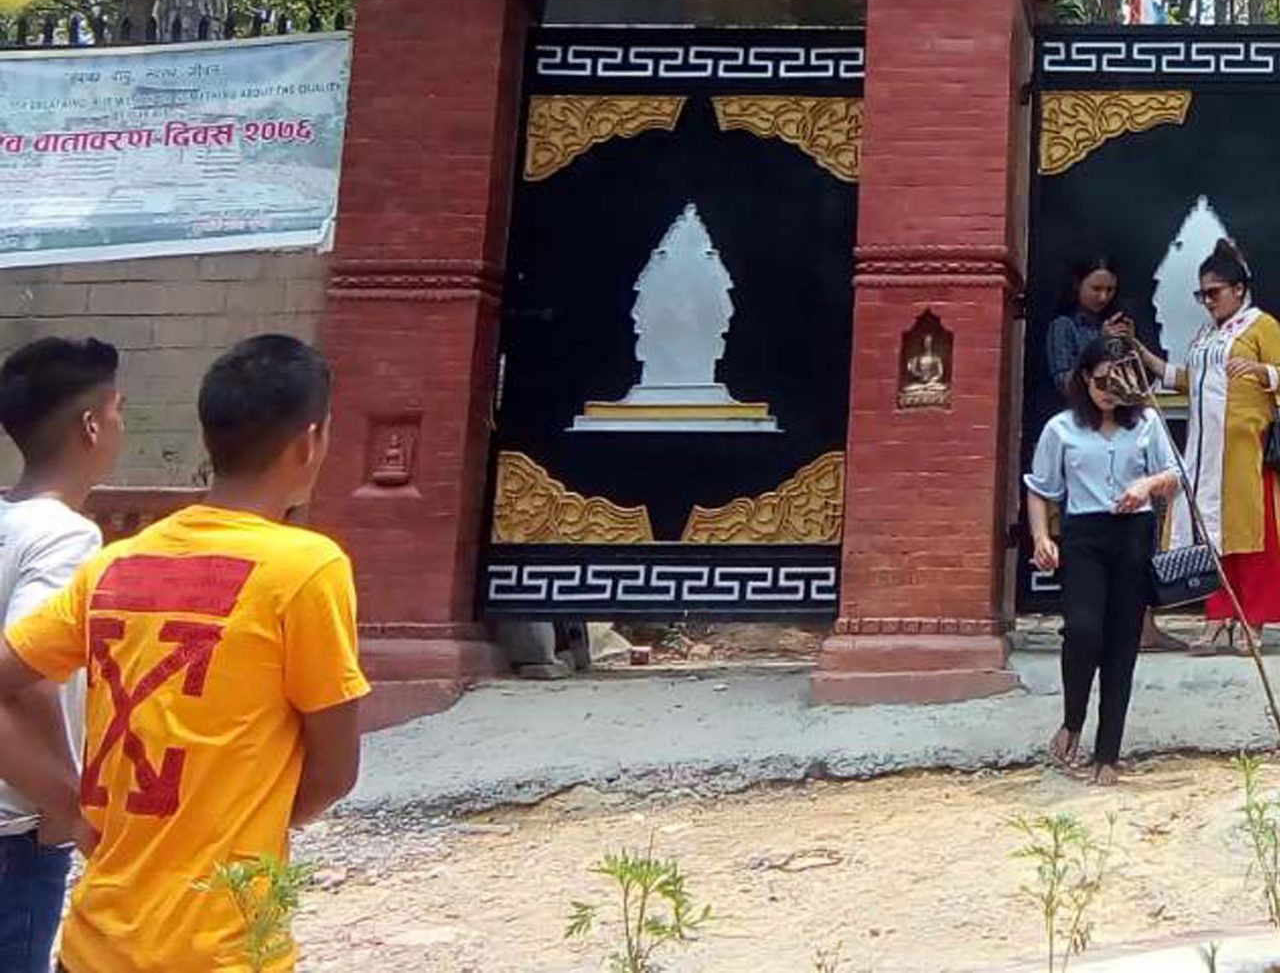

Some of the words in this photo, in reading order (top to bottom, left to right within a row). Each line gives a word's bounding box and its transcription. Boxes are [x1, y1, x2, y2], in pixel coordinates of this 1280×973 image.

[34, 129, 155, 153] वातावरण
[165, 121, 234, 146] दिवस
[244, 118, 315, 142] २०७६
